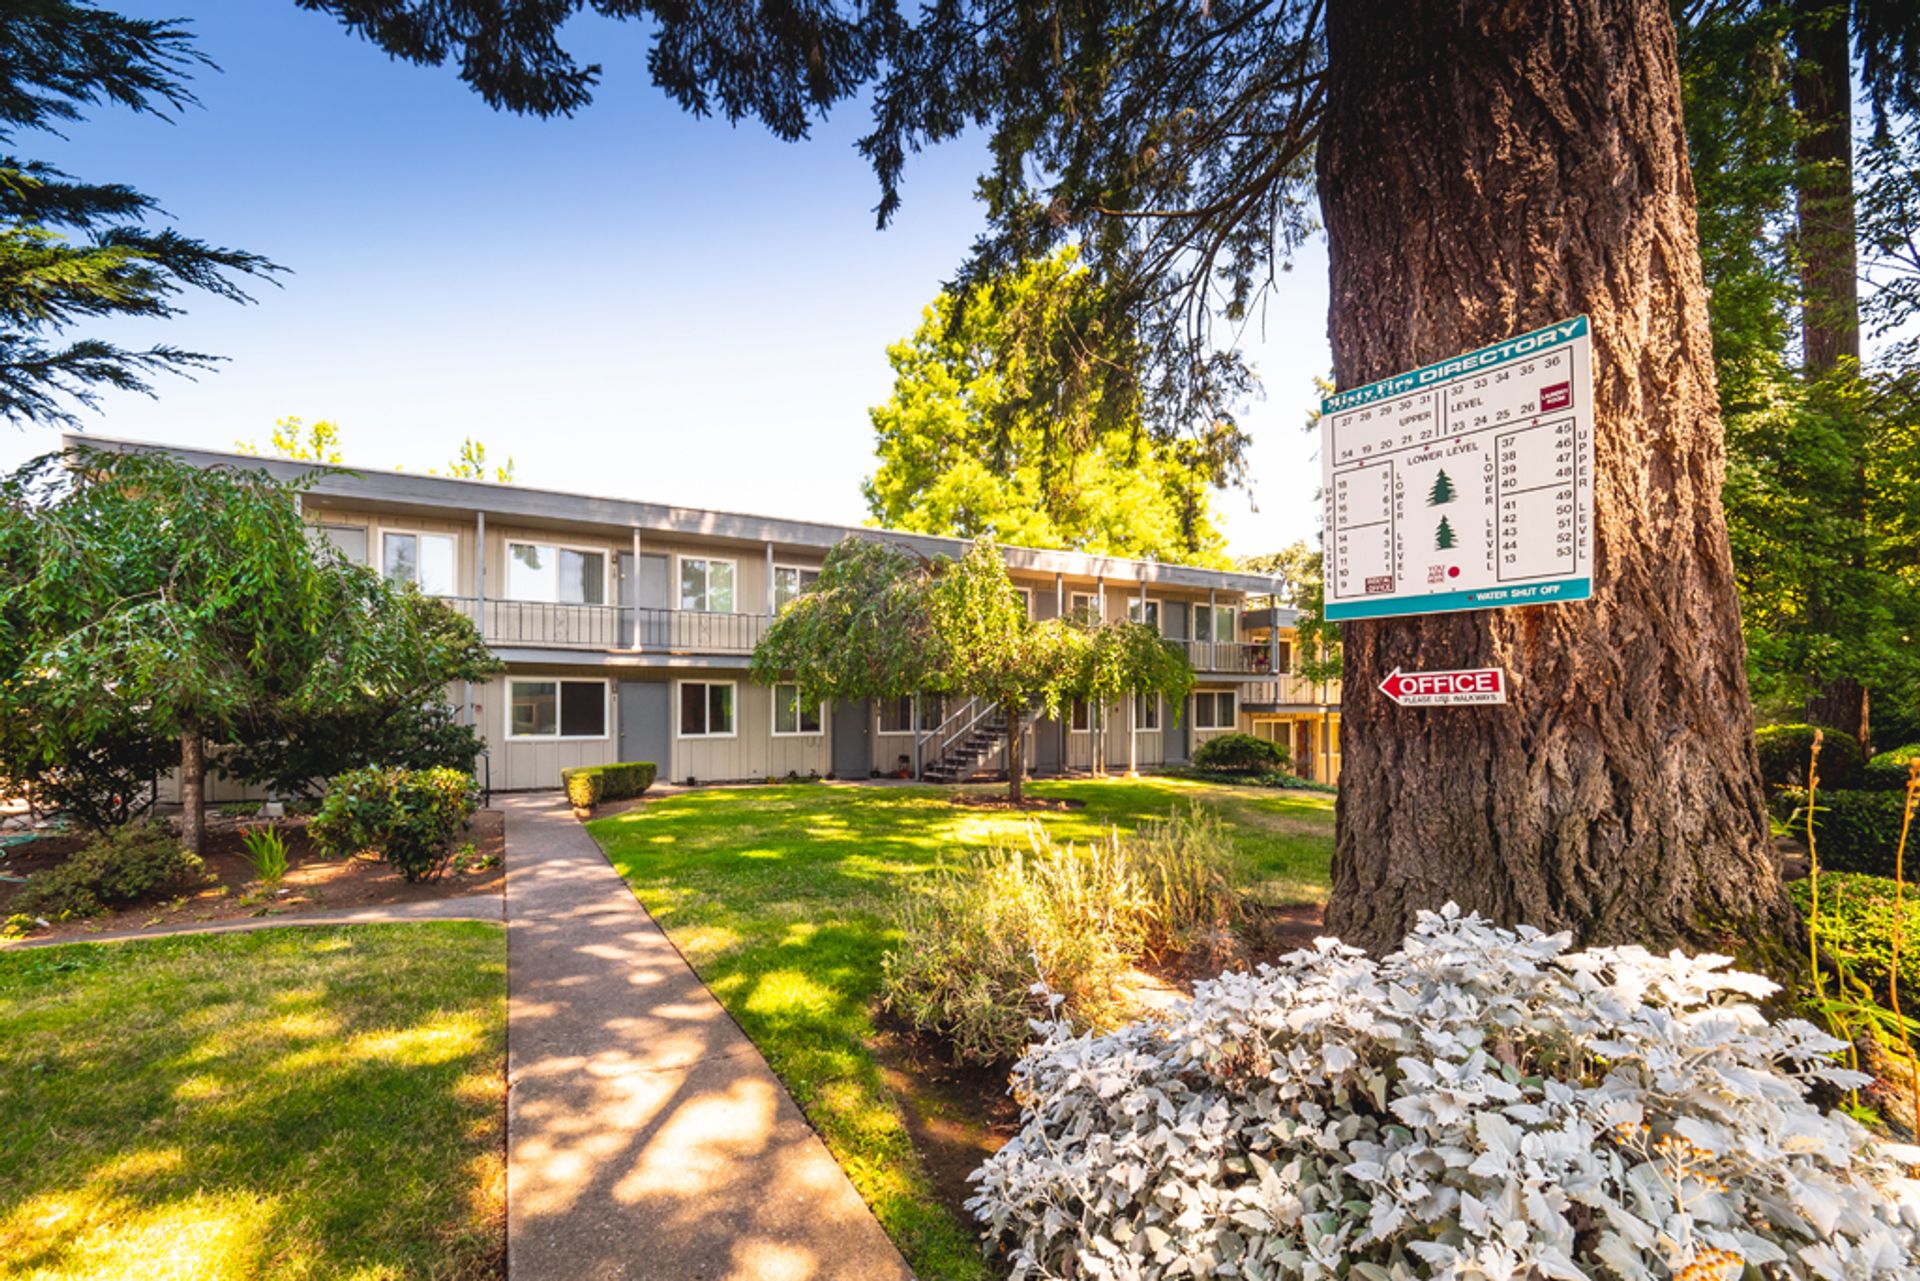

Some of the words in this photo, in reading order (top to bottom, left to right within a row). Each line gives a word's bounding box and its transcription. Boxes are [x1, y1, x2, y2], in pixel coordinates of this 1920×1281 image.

[1328, 390, 1373, 407] Misty
[1377, 378, 1414, 395] Firs
[1419, 321, 1580, 383] DIRECTORY
[1451, 384, 1464, 396] 32
[1473, 378, 1488, 389] 33
[1495, 371, 1510, 384] 34
[1519, 364, 1535, 376] 35
[1544, 356, 1560, 369] 36
[1342, 416, 1353, 427] 27
[1360, 411, 1372, 421] 28
[1380, 406, 1392, 416] 29
[1399, 400, 1412, 411] 30
[1420, 395, 1431, 405] 31
[1399, 410, 1431, 426] UPPER
[1450, 397, 1484, 413] LEVEL
[1452, 420, 1466, 432] 23
[1474, 414, 1488, 426] 24
[1496, 408, 1511, 421] 25
[1520, 401, 1535, 414] 26
[1555, 423, 1572, 434] 45
[1341, 450, 1353, 459] 54
[1362, 444, 1372, 454] 19
[1380, 440, 1392, 450] 20
[1401, 434, 1413, 445] 21
[1420, 429, 1433, 440] 22
[1501, 437, 1516, 448] 37
[1555, 436, 1572, 449] 46
[1407, 449, 1443, 466] LOWER
[1446, 441, 1479, 457] LEVEL
[1501, 451, 1517, 462] 38
[1556, 451, 1572, 463] 47
[1578, 430, 1587, 488] UPPER
[1382, 471, 1389, 479] 8
[1501, 464, 1517, 475] 39
[1555, 466, 1572, 478] 48
[1337, 480, 1347, 489] 18
[1483, 453, 1494, 505] LOWER
[1501, 478, 1517, 488] 40
[1383, 483, 1389, 491] 7
[1338, 492, 1347, 500] 17
[1382, 495, 1389, 504] 6
[1395, 472, 1404, 520] LOWER
[1556, 489, 1572, 500] 49
[1325, 487, 1333, 532] UPPER
[1338, 504, 1347, 512] 16
[1503, 500, 1516, 510] 41
[1556, 503, 1572, 515] 50
[1383, 507, 1390, 516] 5
[1338, 515, 1347, 524] 15
[1502, 514, 1517, 524] 42
[1558, 518, 1571, 529] 51
[1502, 527, 1517, 537] 43
[1578, 502, 1587, 559] LEVEL
[1556, 532, 1572, 543] 52
[1485, 519, 1494, 571] LEVEL
[1502, 540, 1517, 550] 44
[1396, 533, 1404, 580] LEVEL
[1556, 546, 1572, 557] 53
[1504, 553, 1516, 563] 13
[1427, 564, 1445, 572] YOU
[1475, 588, 1508, 601] WATER
[1511, 586, 1536, 598] SHUT
[1540, 584, 1561, 596] OFF
[1399, 673, 1494, 694] OFFICE
[1403, 695, 1431, 704] PLEASE
